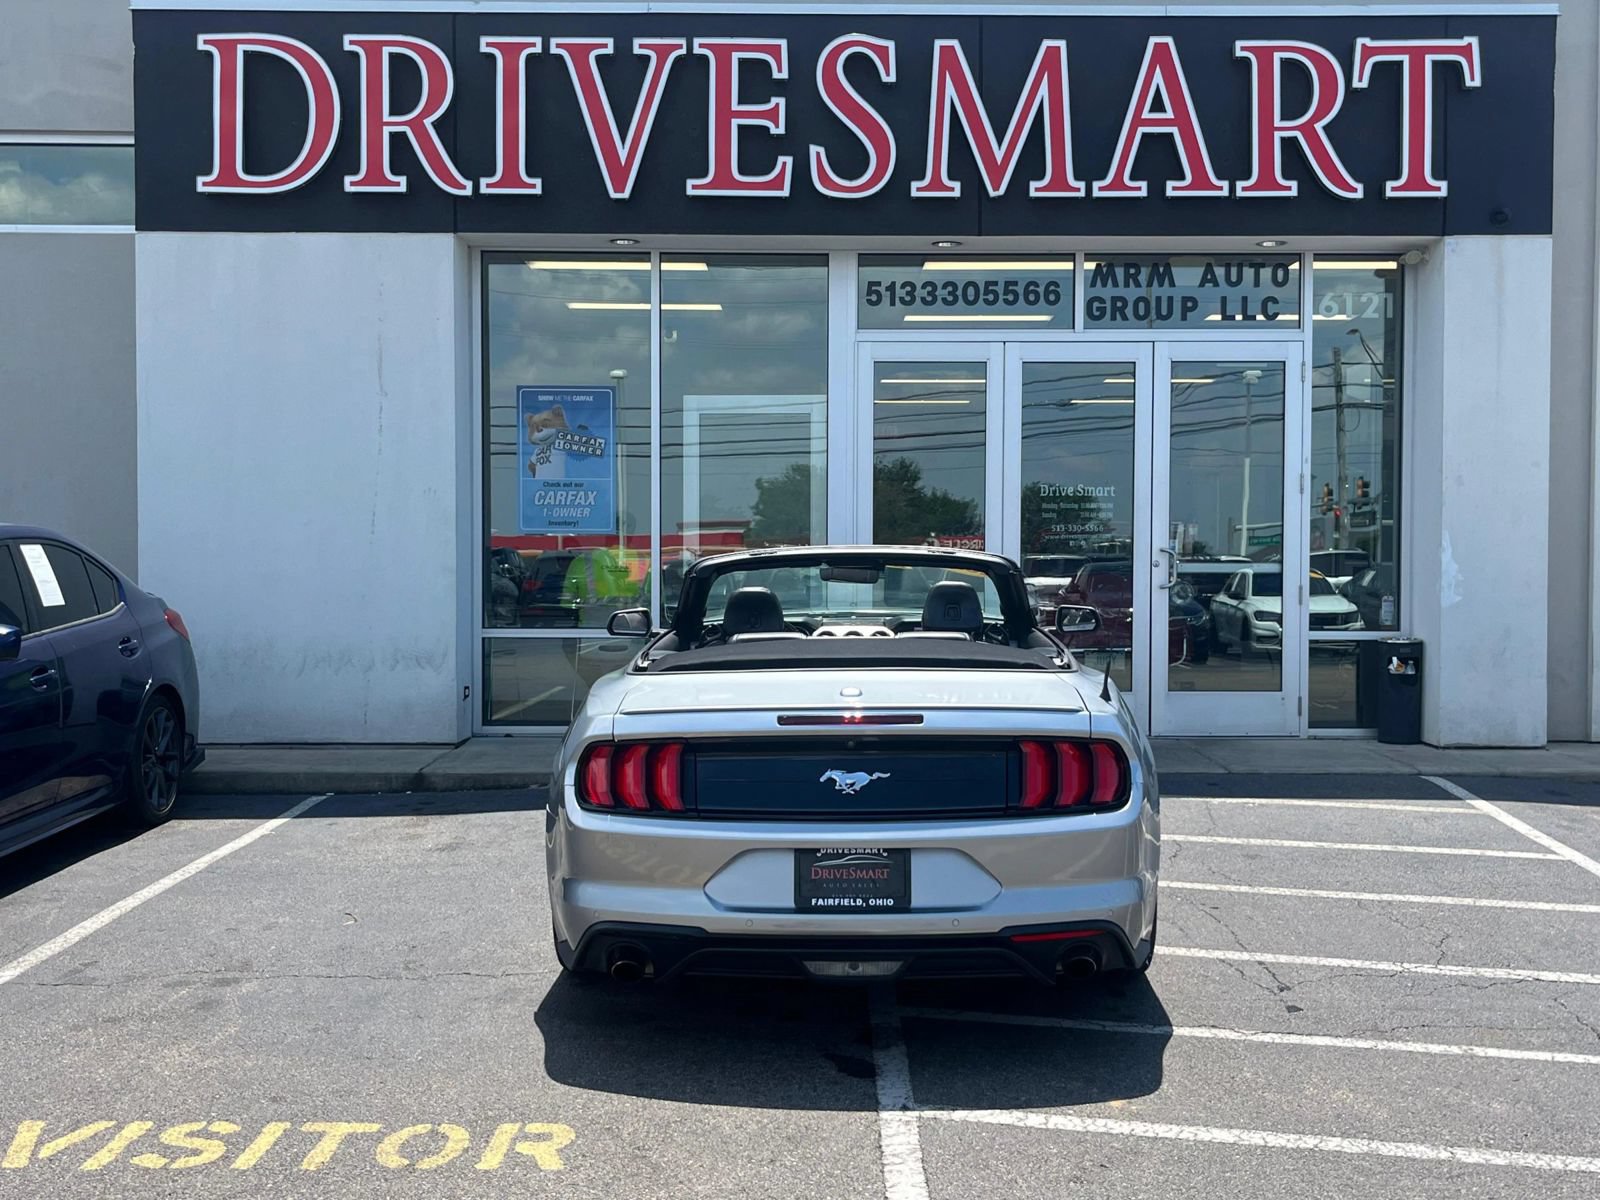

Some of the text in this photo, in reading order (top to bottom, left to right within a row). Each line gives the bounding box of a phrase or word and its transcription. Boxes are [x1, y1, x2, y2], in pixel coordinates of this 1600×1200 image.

[197, 33, 1482, 200] DRIVESMART
[1089, 262, 1290, 288] MRM AUTO
[865, 280, 1061, 307] 5133305566
[1086, 295, 1281, 321] GROUP LLC
[1318, 292, 1393, 318] 6121
[558, 432, 605, 448] CARFAX
[534, 490, 598, 505] CARFAX
[1040, 483, 1116, 497] Drive Smart
[543, 507, 591, 518] 1-OWNER
[1051, 524, 1104, 532] 513-330-5566
[811, 898, 894, 907] FAIRFIELD, OHIO
[1, 1120, 577, 1171] VISITOR
